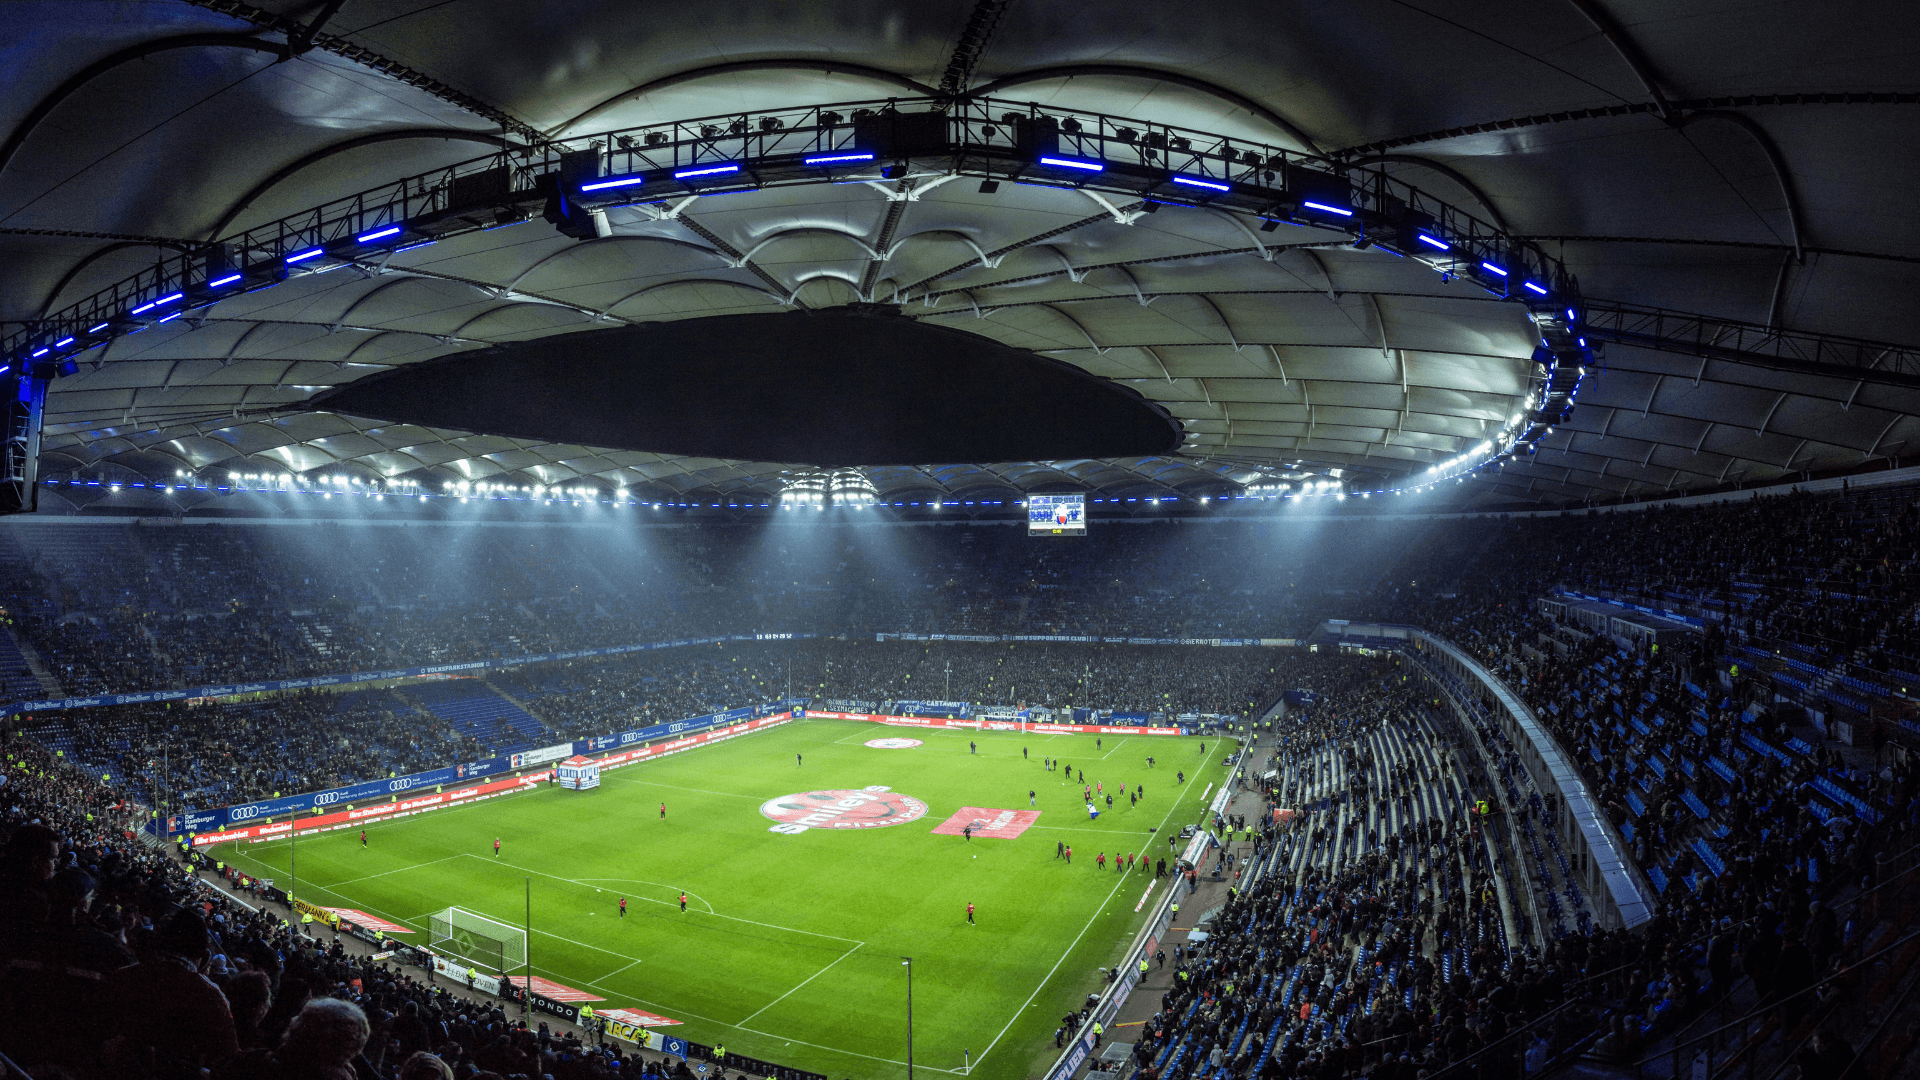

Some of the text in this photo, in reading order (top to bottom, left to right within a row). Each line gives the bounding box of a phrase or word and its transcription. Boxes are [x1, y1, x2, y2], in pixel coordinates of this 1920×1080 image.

[427, 662, 485, 673] VOLKSPARKSTADION
[185, 816, 215, 825] Hamburger
[195, 836, 209, 845] Elbe
[209, 831, 249, 843] Wochenblatt
